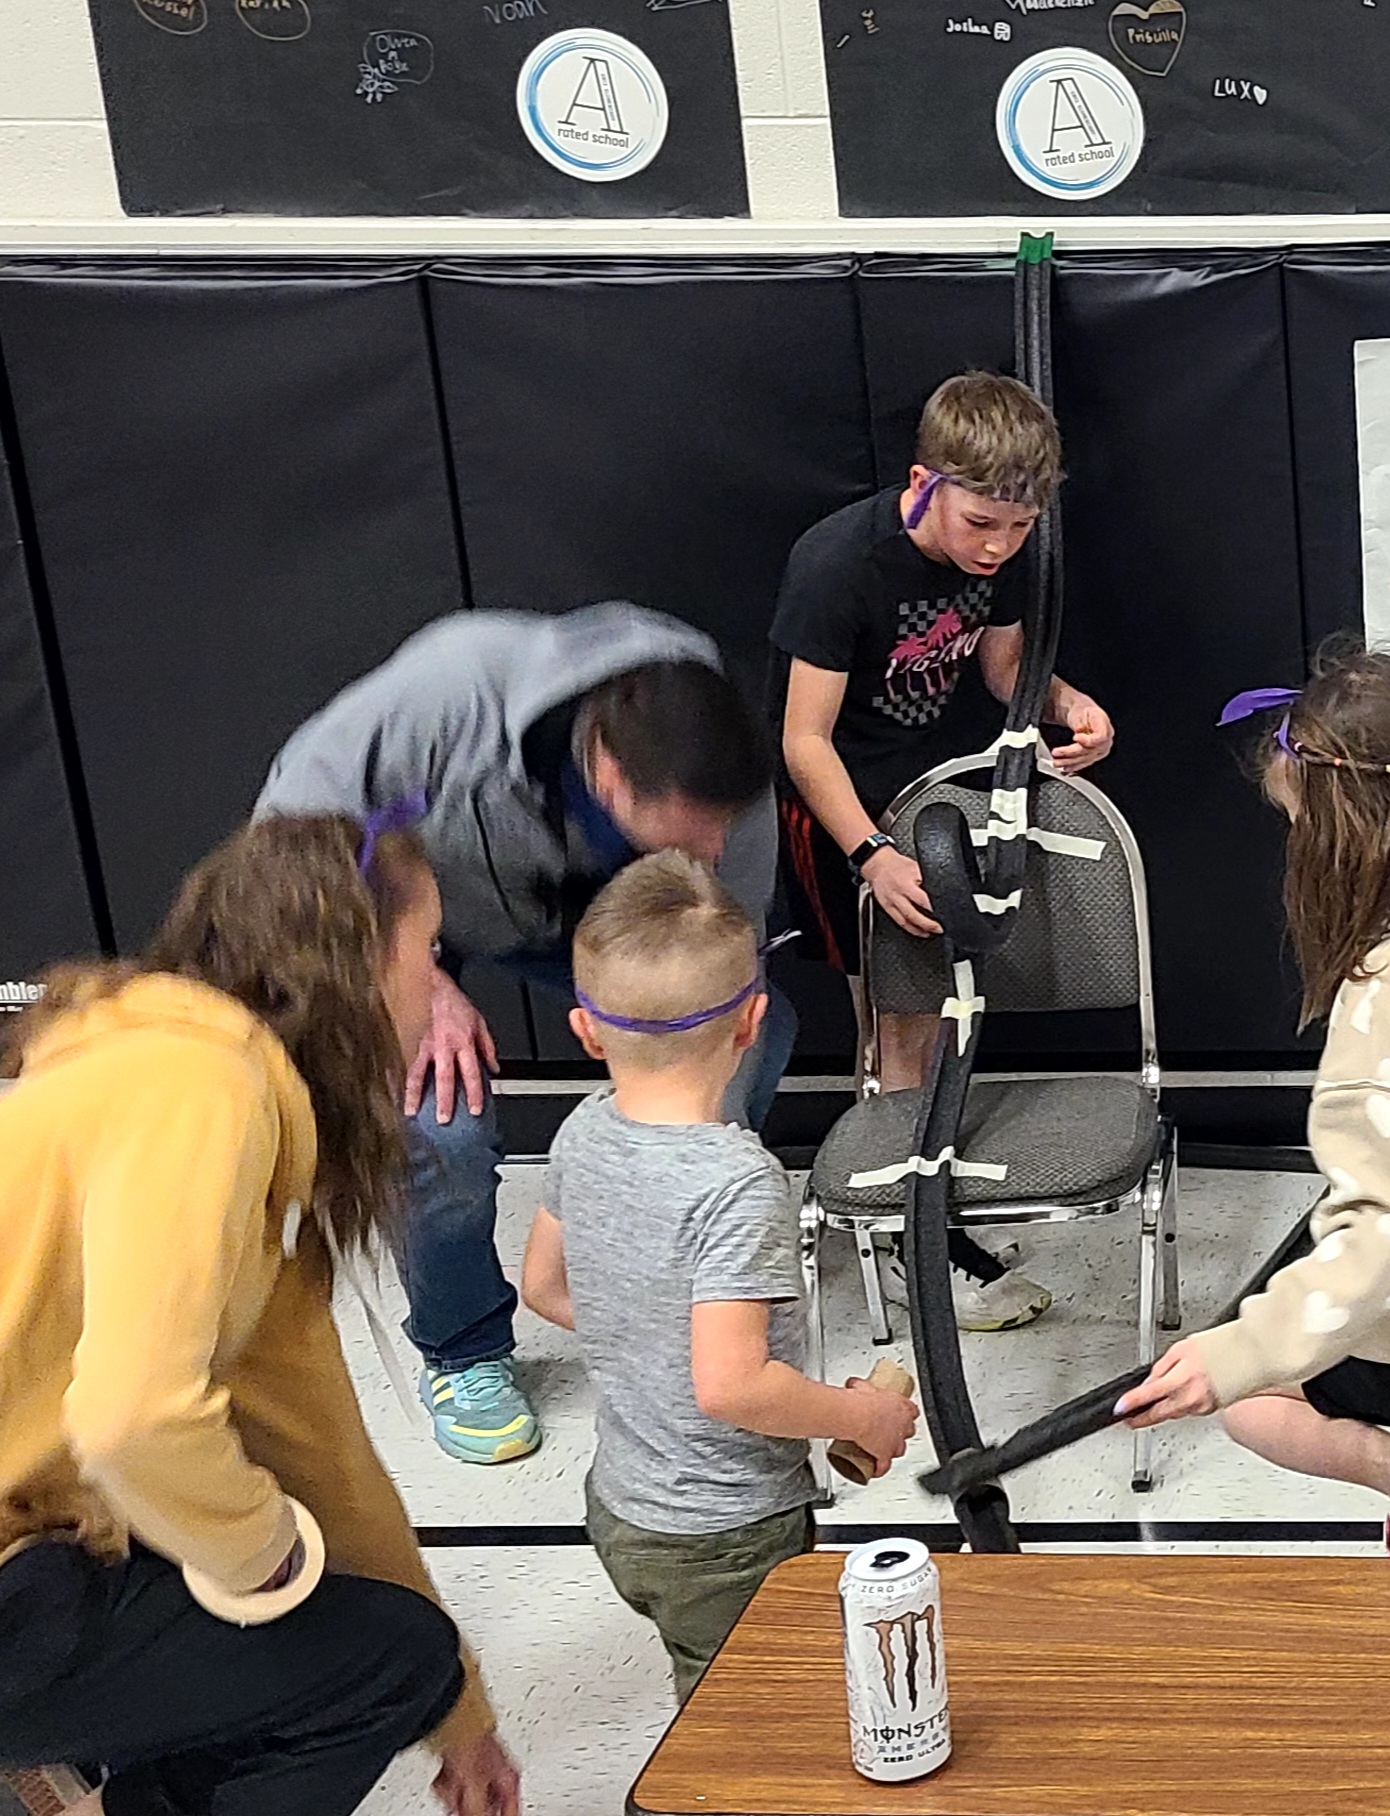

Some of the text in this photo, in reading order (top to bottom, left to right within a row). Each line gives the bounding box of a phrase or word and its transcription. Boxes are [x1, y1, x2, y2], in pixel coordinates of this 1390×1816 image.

[557, 56, 630, 135] A
[1042, 77, 1113, 153] A
[557, 128, 629, 149] rated school
[1044, 146, 1115, 167] rated school
[861, 1566, 933, 1594] ZERO SUGAR
